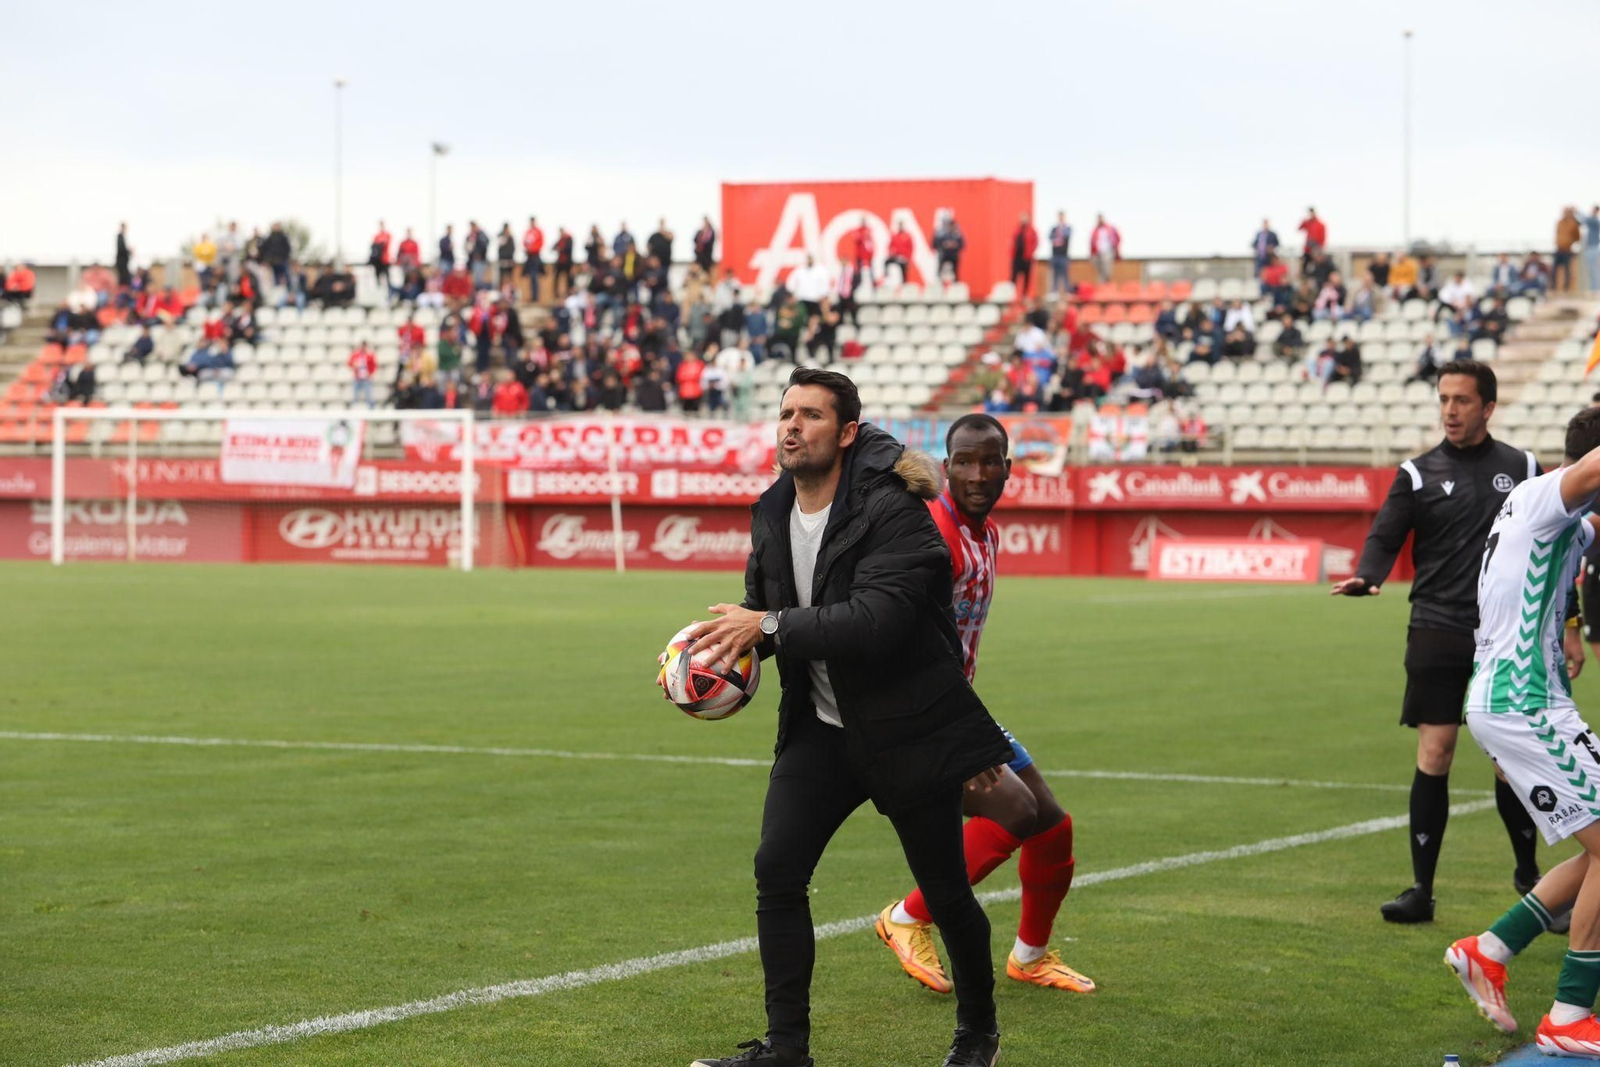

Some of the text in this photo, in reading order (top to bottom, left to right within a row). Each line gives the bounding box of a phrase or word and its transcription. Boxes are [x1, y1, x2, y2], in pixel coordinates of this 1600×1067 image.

[1124, 471, 1224, 498] CaixaBank
[1267, 472, 1370, 498] CaixaBank
[1548, 803, 1583, 826] RABAL
